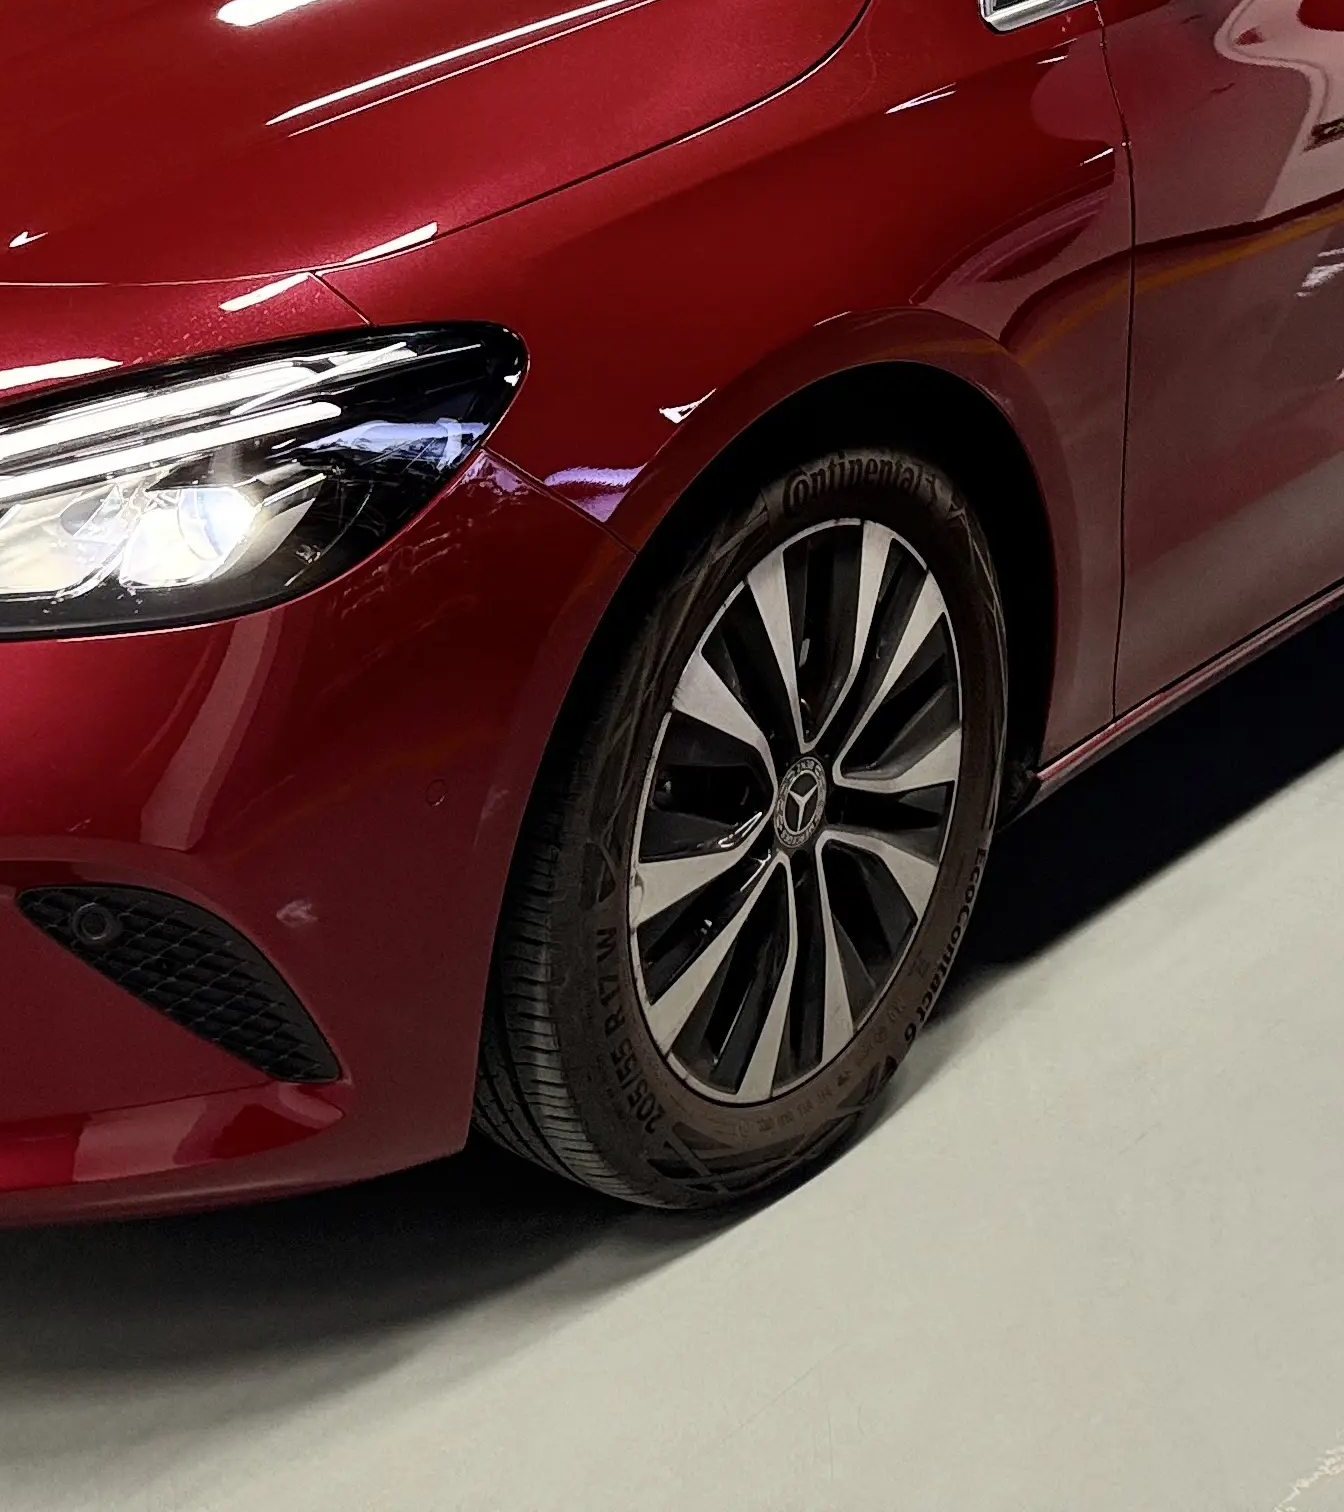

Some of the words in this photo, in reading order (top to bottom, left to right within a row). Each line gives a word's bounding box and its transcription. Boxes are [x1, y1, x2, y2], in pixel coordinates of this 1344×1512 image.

[782, 450, 924, 516] Continental
[916, 847, 987, 1022] EcoContact
[611, 1038, 666, 1135] 205/55
